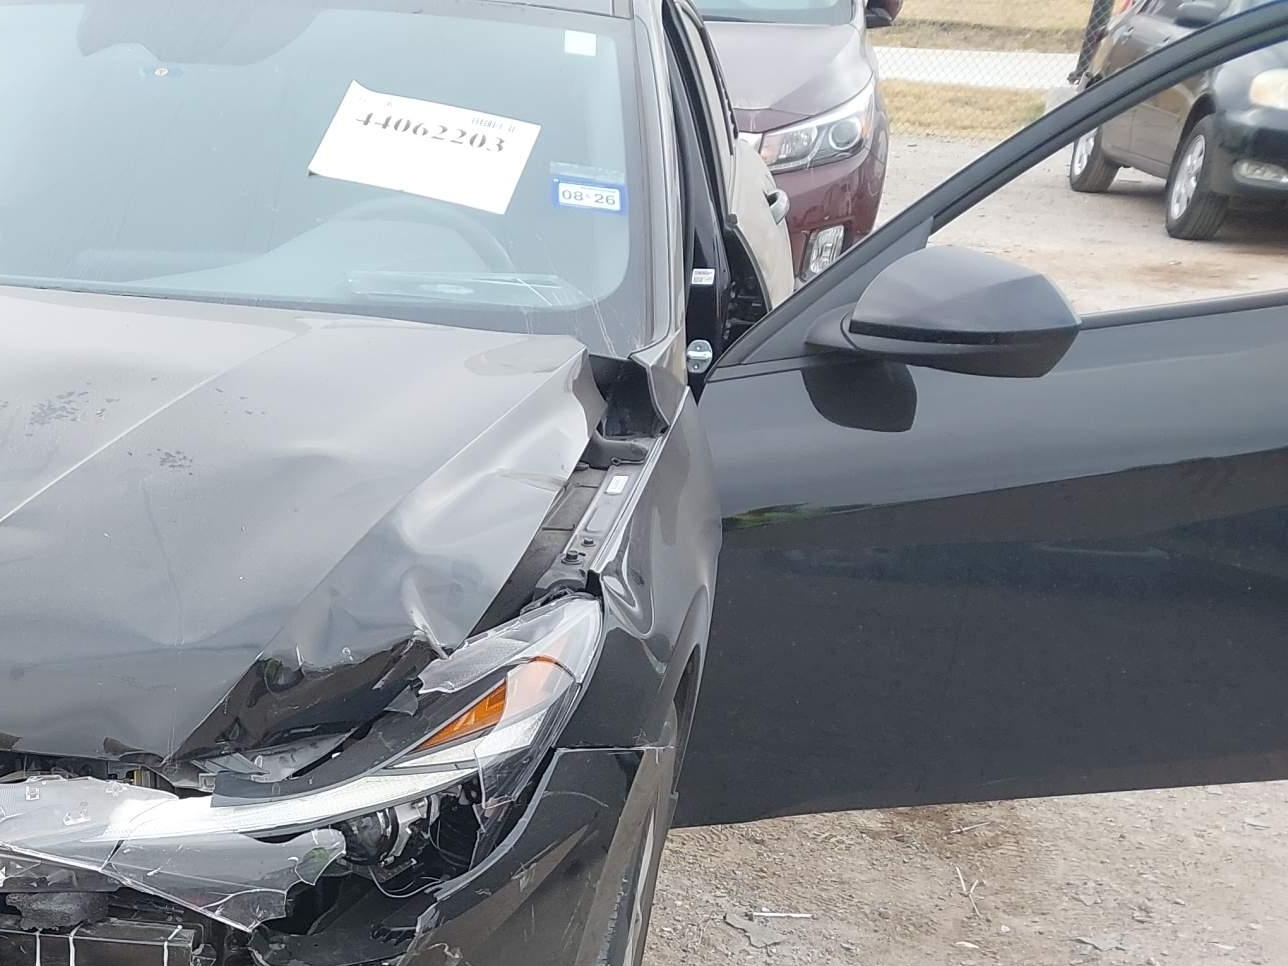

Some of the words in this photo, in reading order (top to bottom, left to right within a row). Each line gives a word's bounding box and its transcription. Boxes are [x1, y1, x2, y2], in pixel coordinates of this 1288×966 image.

[355, 112, 505, 152] 44062203
[561, 189, 584, 201] 08
[593, 193, 616, 206] 26
